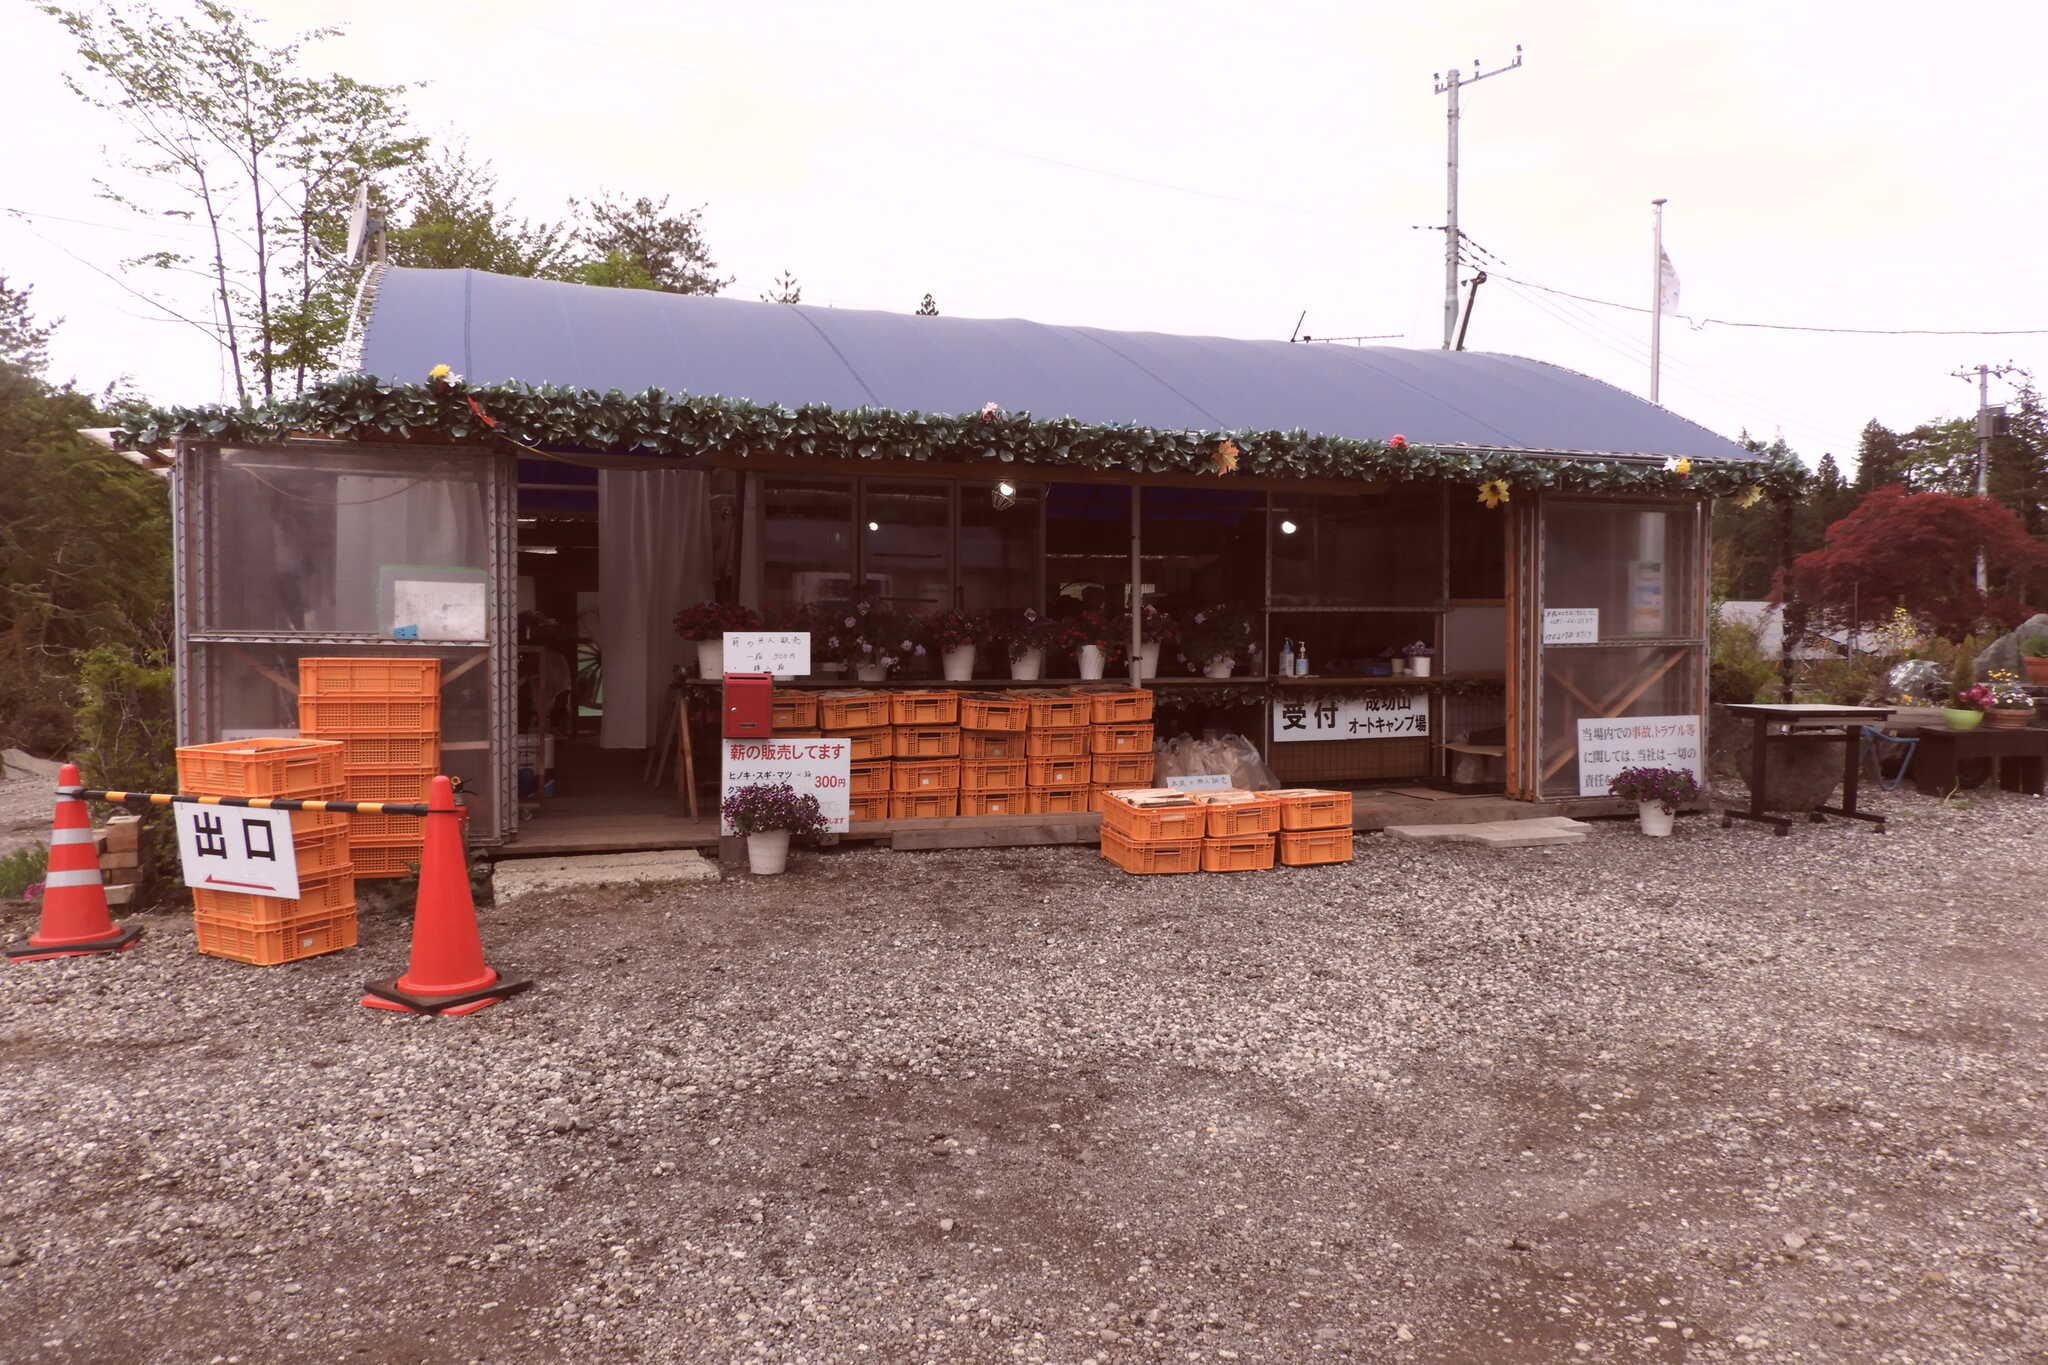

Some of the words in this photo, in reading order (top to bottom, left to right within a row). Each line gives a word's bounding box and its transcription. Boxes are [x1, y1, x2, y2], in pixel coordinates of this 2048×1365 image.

[1282, 702, 1338, 730] 受付
[1348, 714, 1427, 734] オートキャンプ場
[730, 744, 845, 761] 薪の販売してます
[815, 775, 846, 789] 300円
[194, 811, 276, 861] 出口
